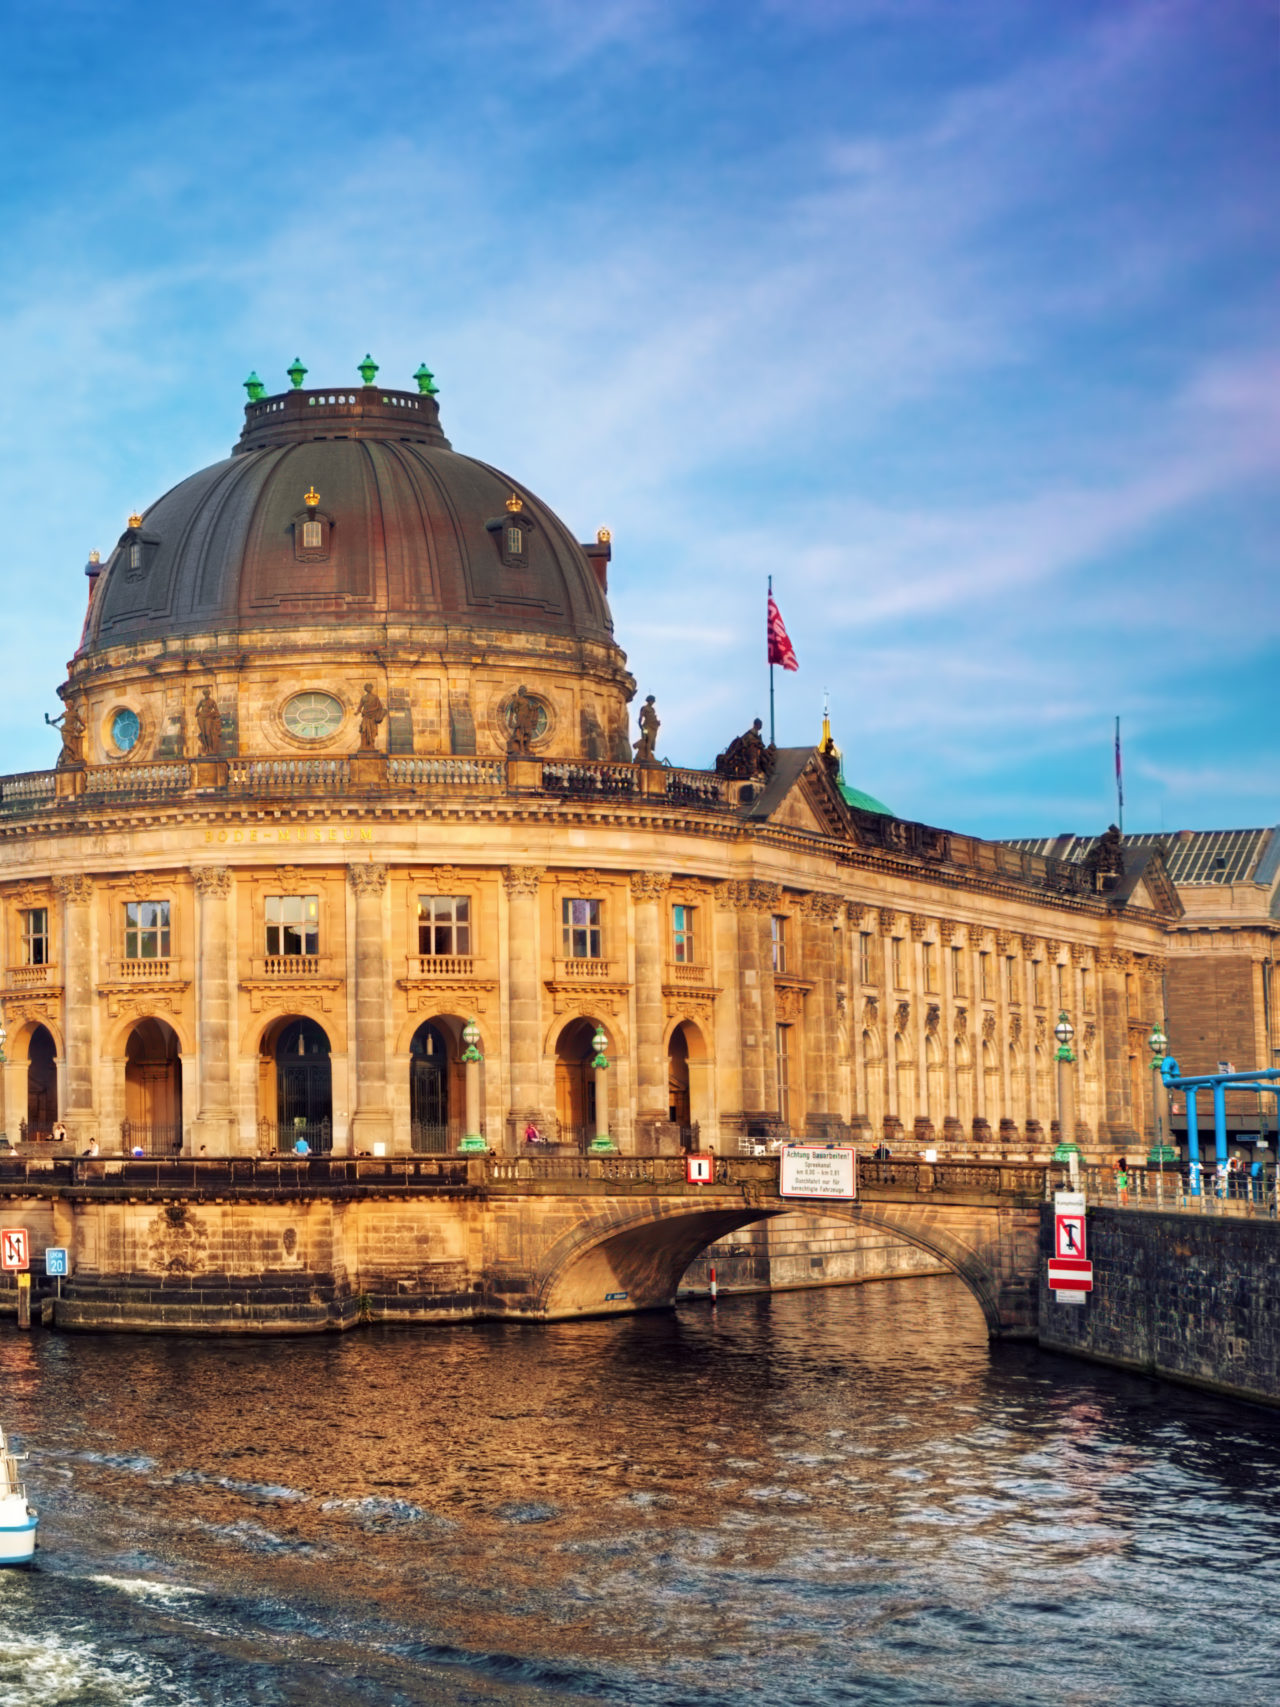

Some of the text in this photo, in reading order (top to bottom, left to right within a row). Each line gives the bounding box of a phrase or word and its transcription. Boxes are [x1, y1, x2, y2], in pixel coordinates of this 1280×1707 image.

[205, 828, 373, 843] BODE-MUSEUM
[787, 1151, 850, 1160] Achtung Bauarbeiten!
[51, 1259, 63, 1272] 20
